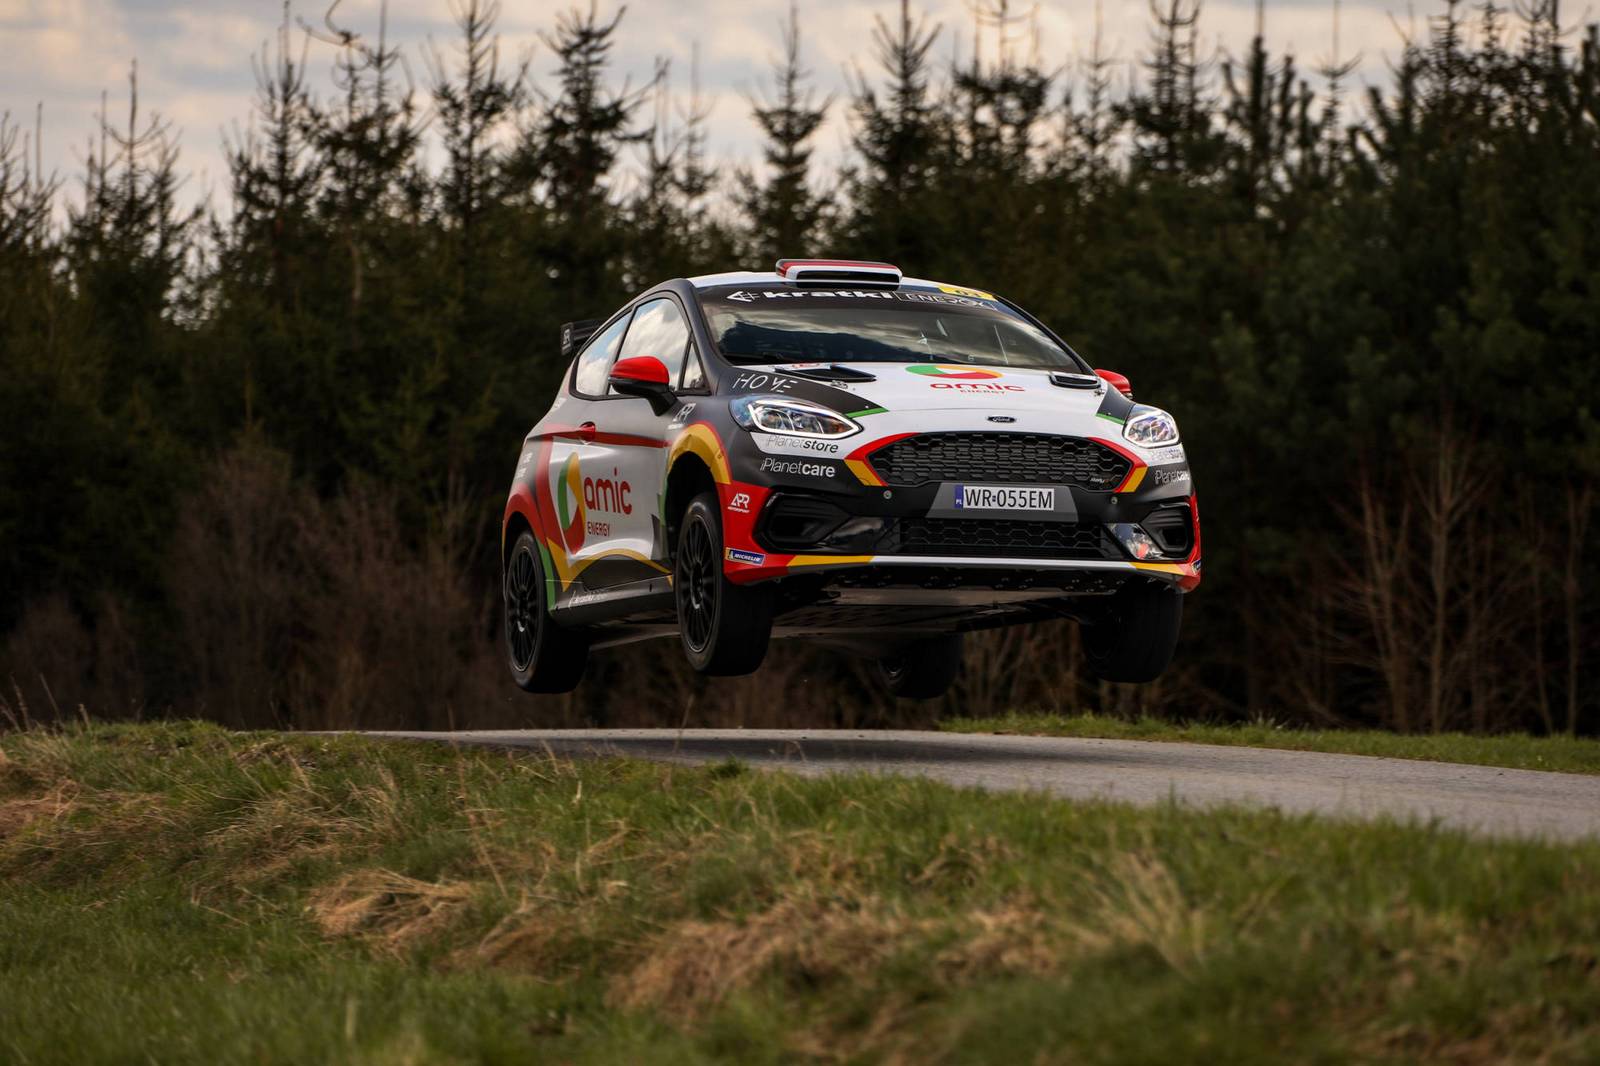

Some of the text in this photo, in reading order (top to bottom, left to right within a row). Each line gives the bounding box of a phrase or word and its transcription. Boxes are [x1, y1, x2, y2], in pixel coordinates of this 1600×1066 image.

[763, 291, 893, 299] kratki
[930, 383, 1025, 392] amic
[760, 457, 836, 478] iPlanetcare
[584, 467, 632, 515] amic
[731, 493, 750, 509] APR
[587, 521, 610, 537] ENERGY
[733, 553, 761, 563] MICHELIN
